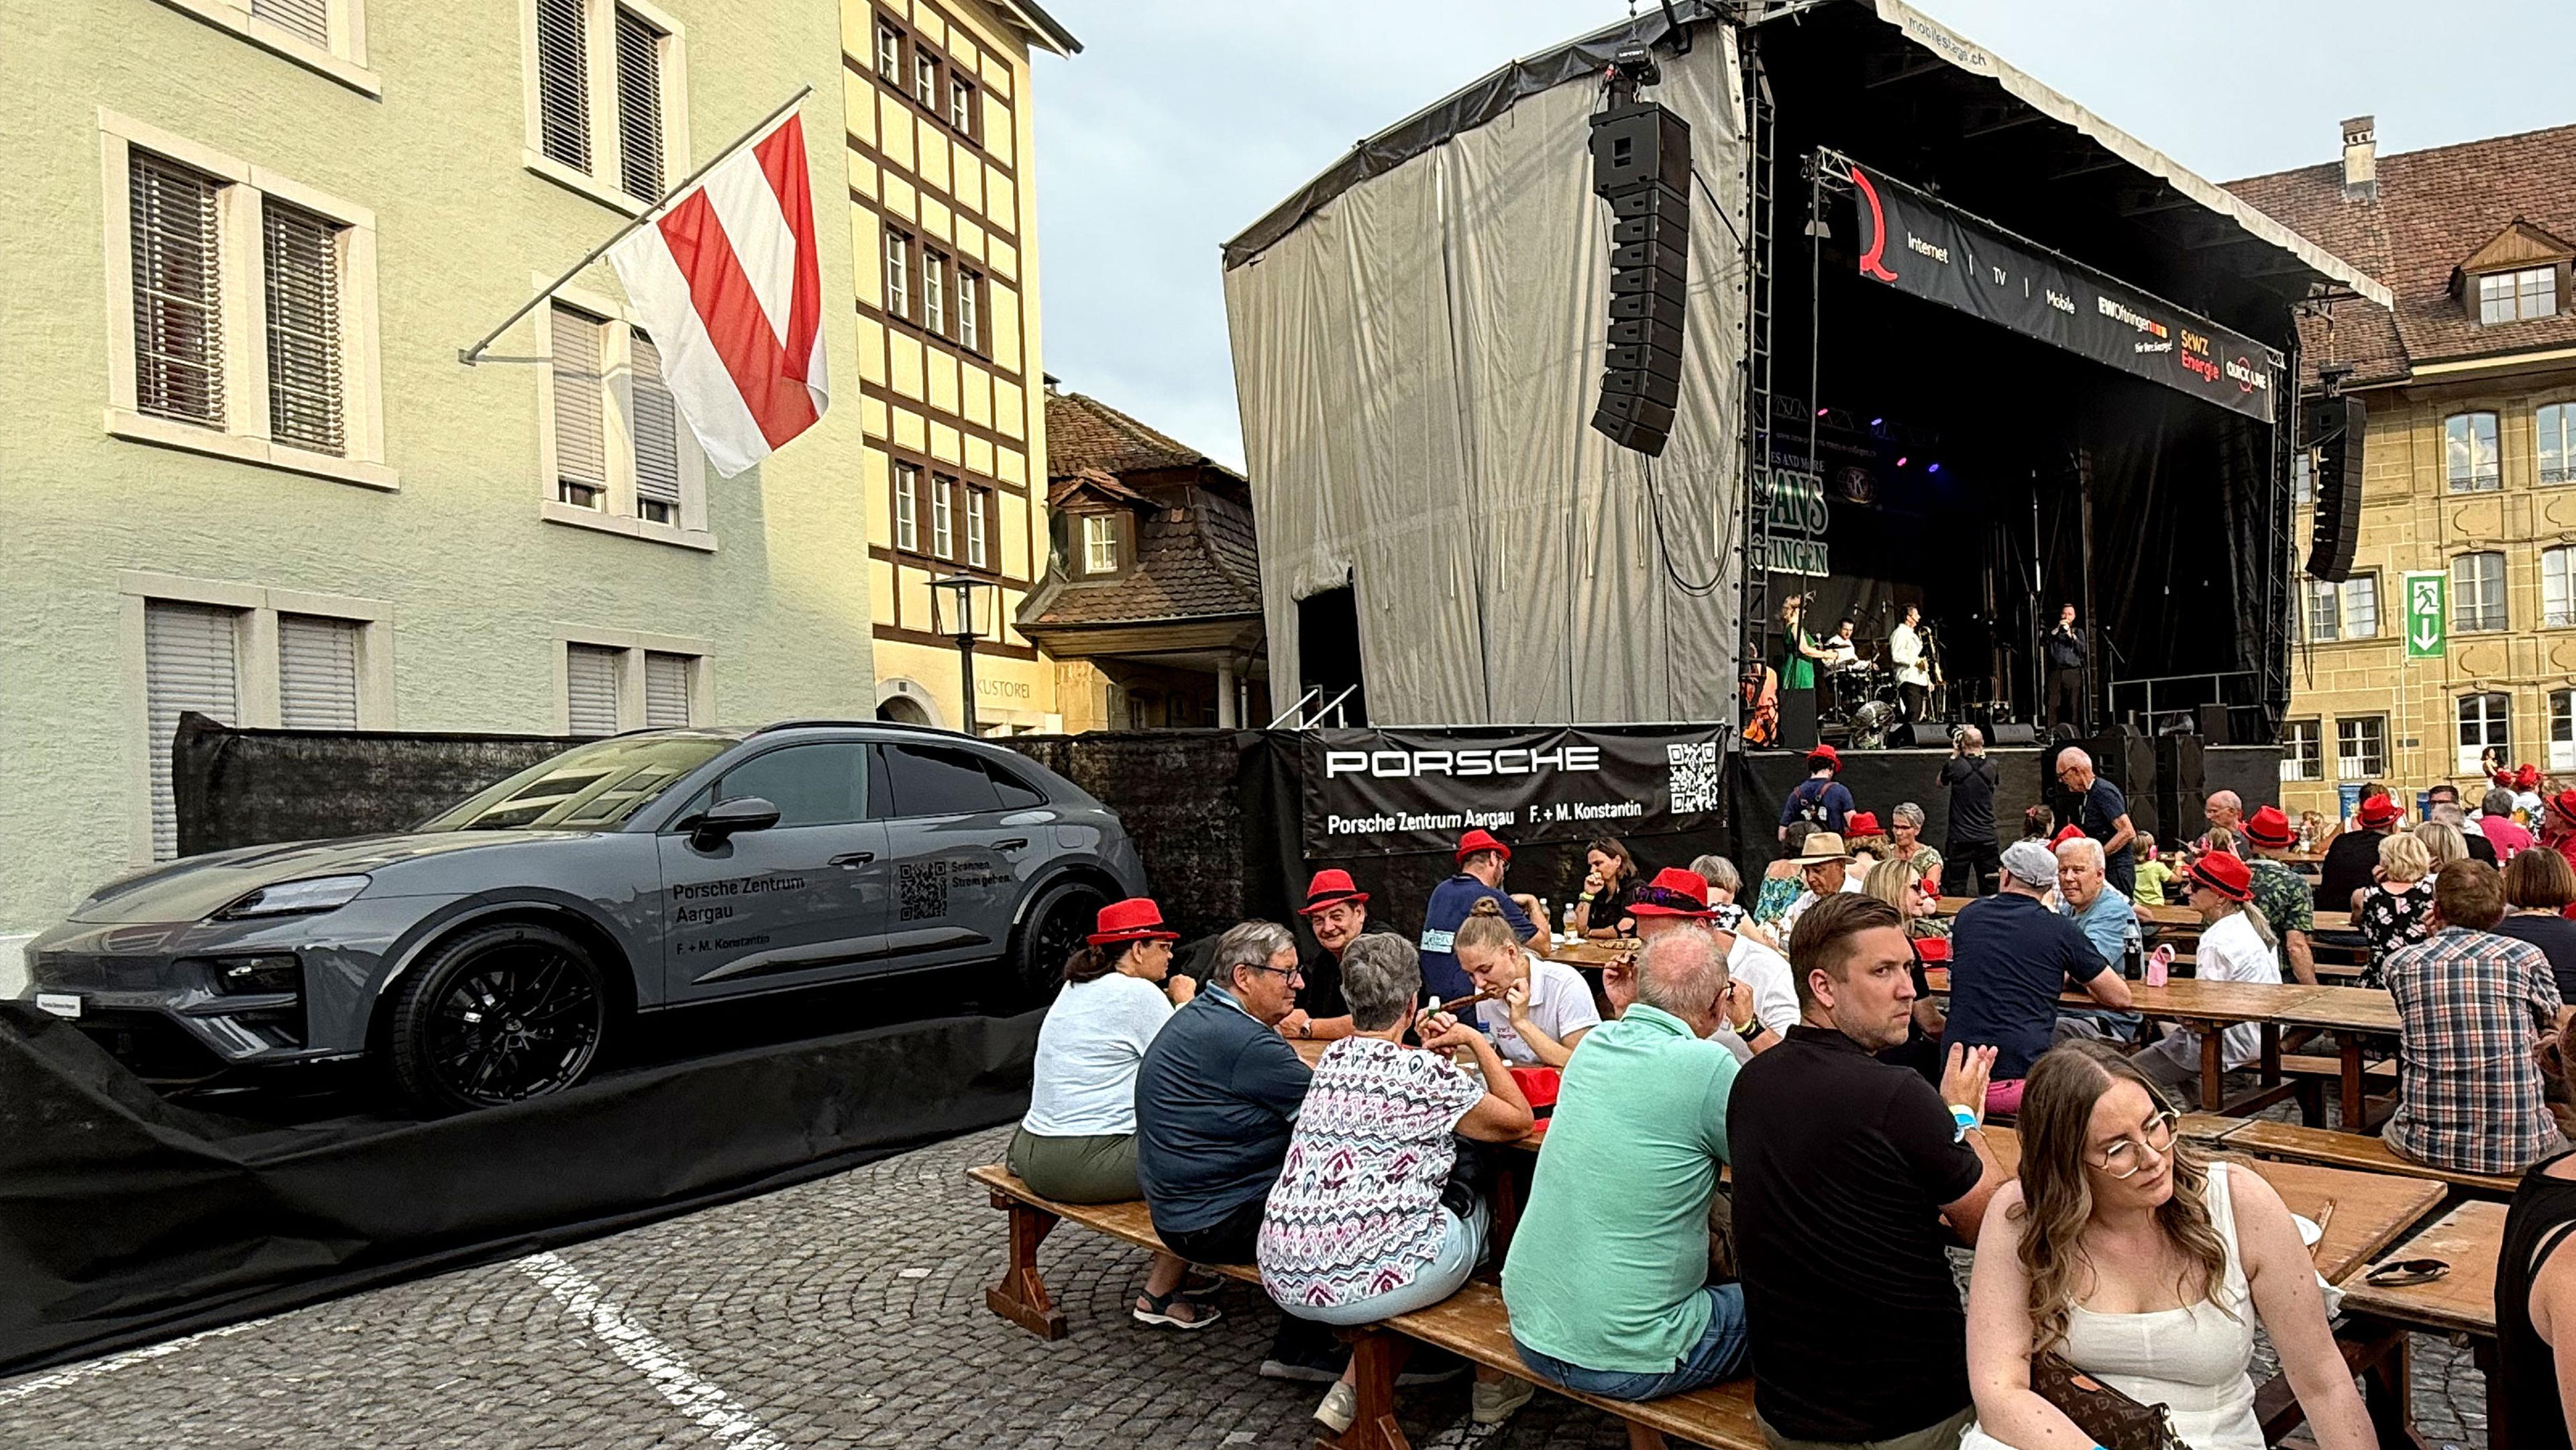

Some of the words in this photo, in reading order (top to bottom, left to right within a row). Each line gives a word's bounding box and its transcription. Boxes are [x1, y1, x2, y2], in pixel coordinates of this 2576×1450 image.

[1908, 231, 1949, 264] Internet
[1992, 266, 2007, 286] TV
[2046, 289, 2076, 315] Mobile
[2181, 329, 2210, 356] StWZ
[2181, 349, 2219, 382] Energie
[1782, 453, 1800, 468] AND
[977, 679, 1030, 698] KUSTOREI
[1326, 746, 1599, 778] PORSCHE
[1328, 813, 1395, 835] Porsche
[1396, 812, 1461, 831] Zentrum
[1464, 808, 1515, 831] Aargau
[1529, 805, 1542, 823] F.
[1543, 808, 1554, 820] +
[1556, 802, 1572, 822] M.
[1574, 799, 1642, 821] Konstantin
[673, 880, 738, 900] Porsche
[740, 876, 806, 894] Zentrum
[676, 905, 734, 925] Aargau
[688, 943, 696, 953] +
[698, 939, 712, 953] M.
[714, 934, 771, 951] Konstantin
